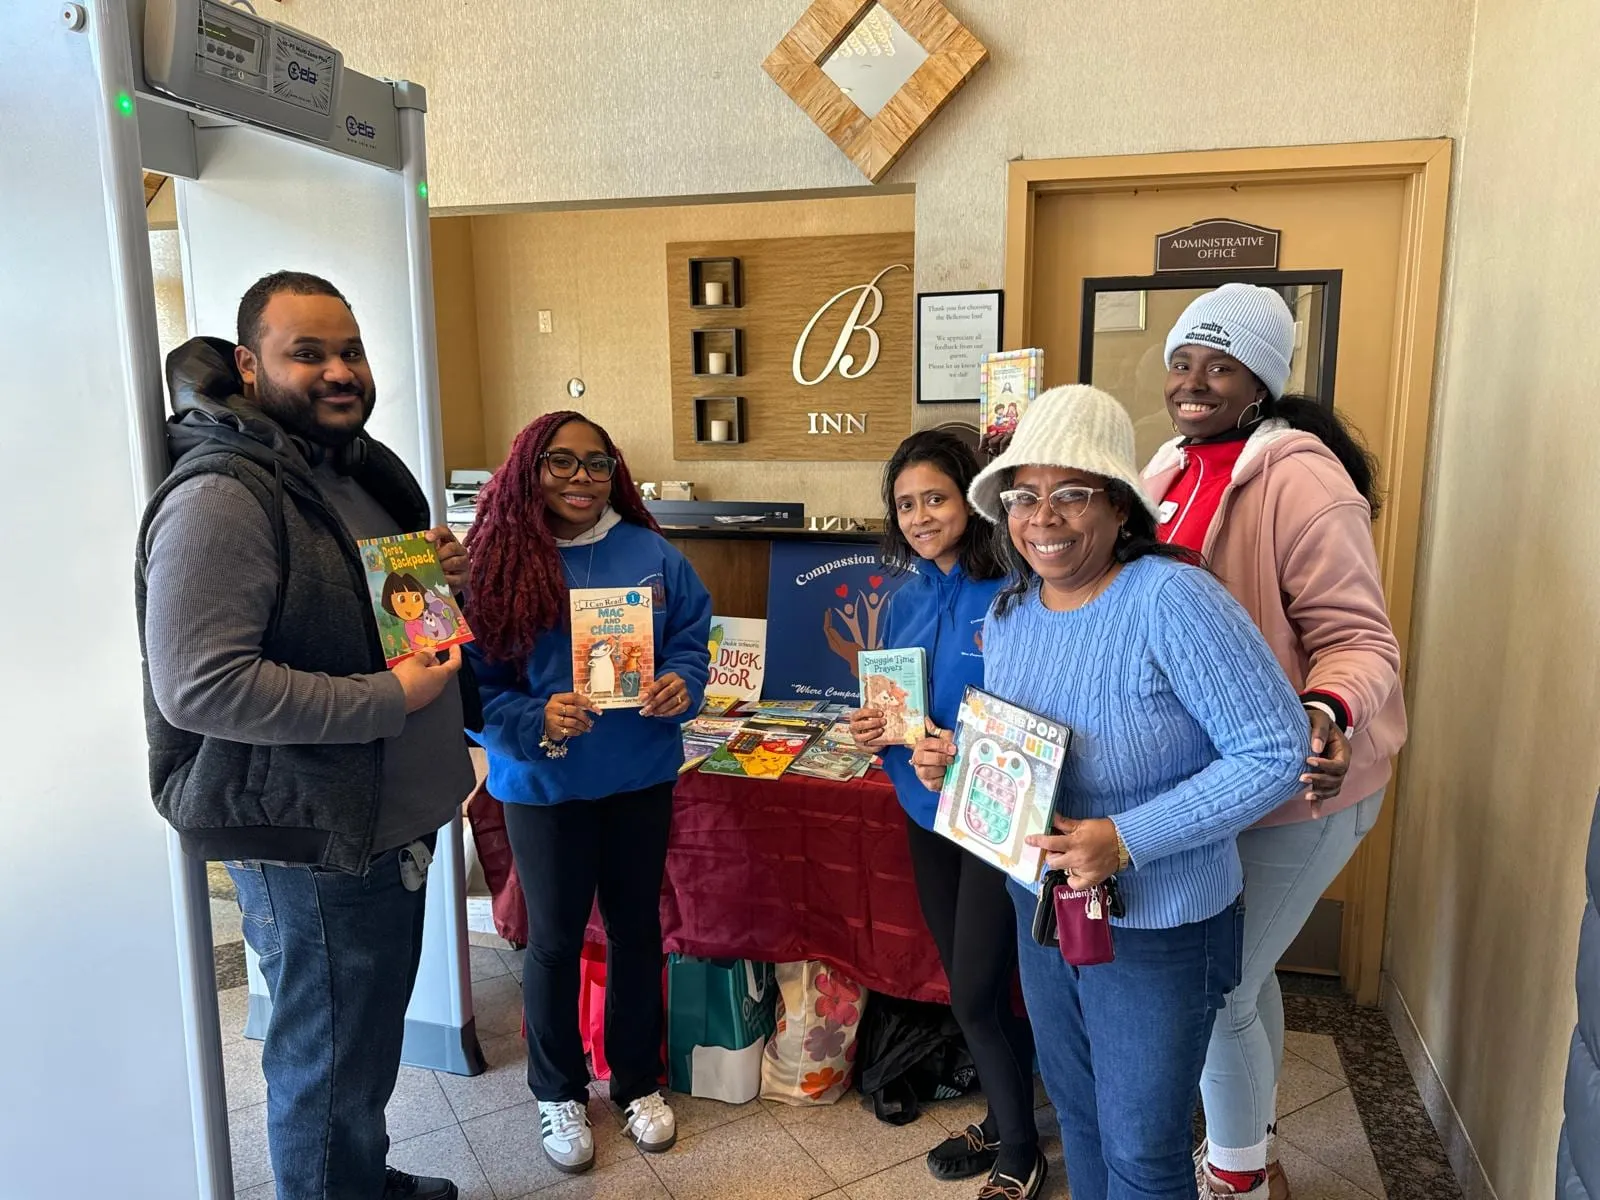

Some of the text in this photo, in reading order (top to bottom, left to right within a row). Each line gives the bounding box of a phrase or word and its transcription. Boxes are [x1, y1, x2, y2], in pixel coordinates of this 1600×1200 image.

[1171, 236, 1265, 249] ADMINISTRATIVE
[1197, 248, 1237, 259] OFFICE
[792, 263, 910, 386] B
[1200, 321, 1223, 335] unity
[1184, 332, 1231, 347] abundance
[807, 412, 868, 435] INN
[390, 548, 436, 571] Backpack
[795, 553, 876, 586] Compassion
[597, 607, 625, 619] MAC
[604, 617, 621, 625] AND
[590, 623, 635, 636] CHEESE
[719, 648, 763, 671] DUCK
[864, 653, 915, 667] Snuggle Time
[874, 664, 903, 674] Prayers
[706, 666, 757, 691] DOOR
